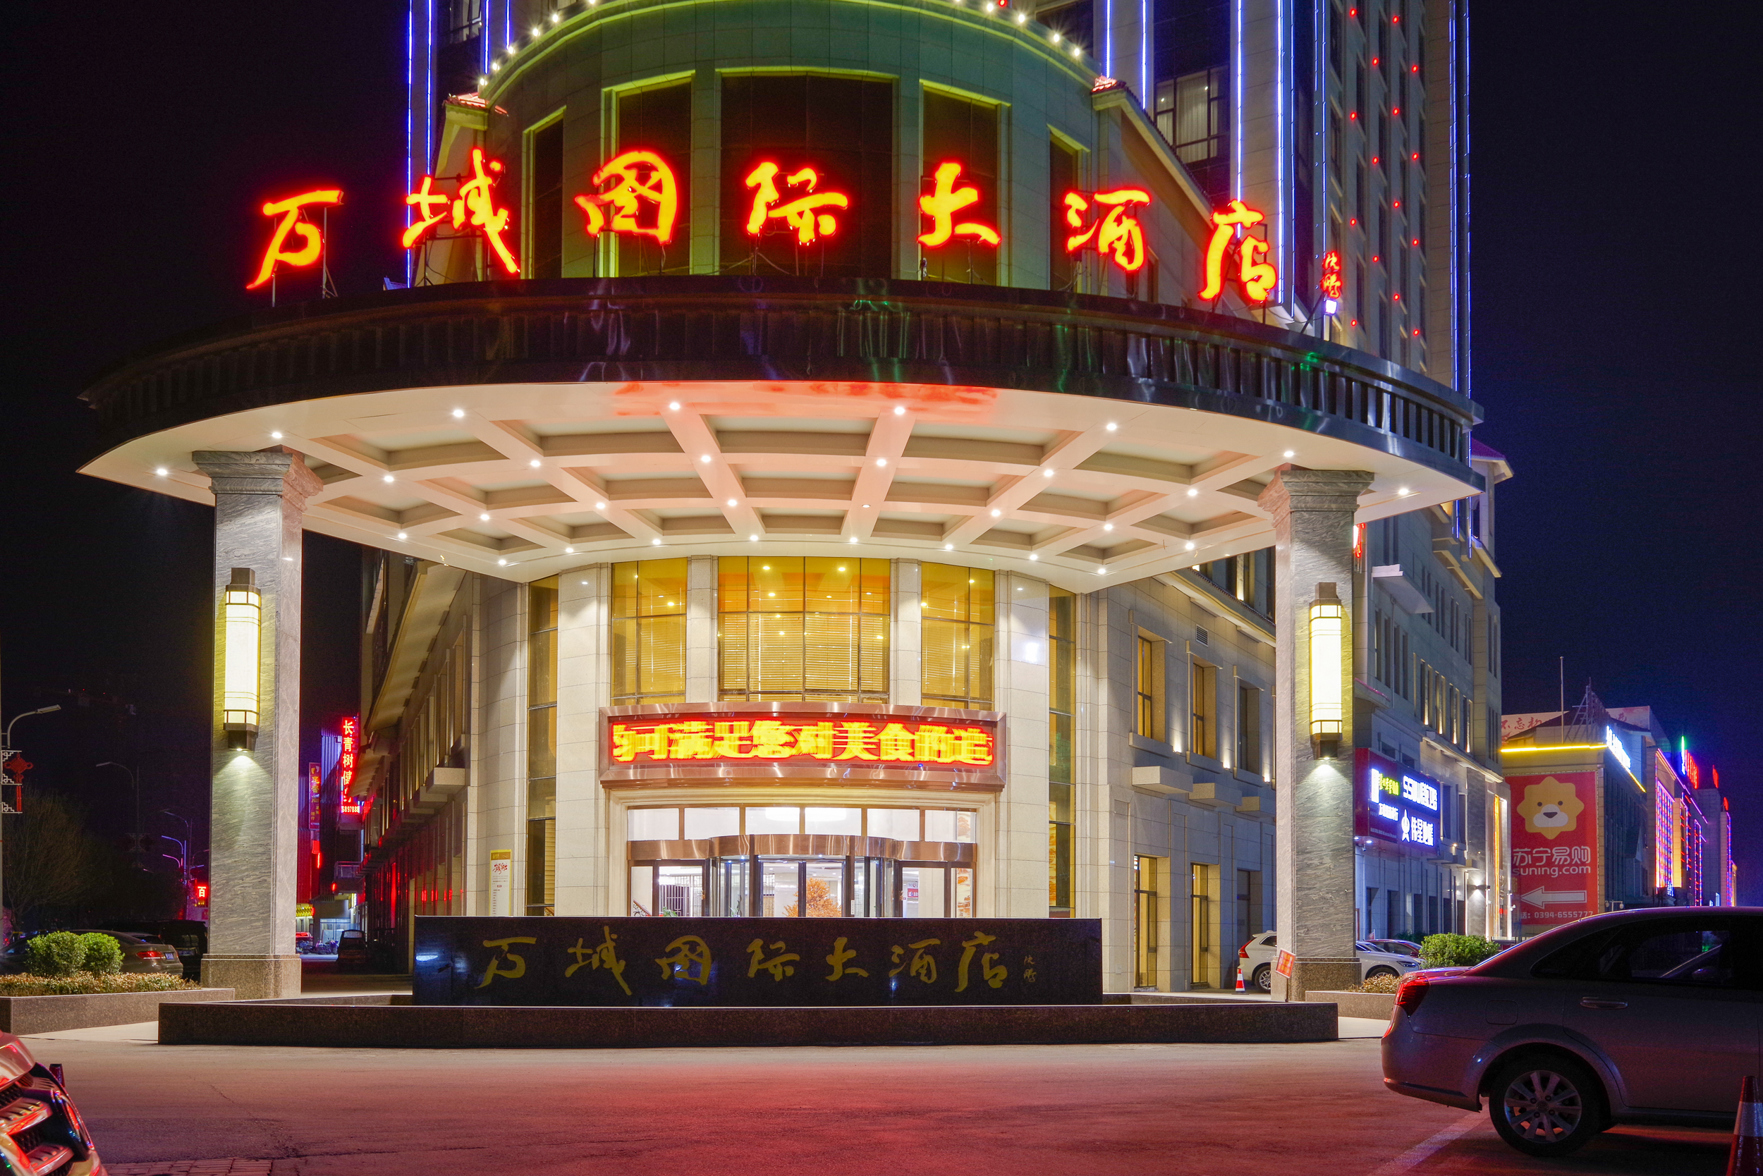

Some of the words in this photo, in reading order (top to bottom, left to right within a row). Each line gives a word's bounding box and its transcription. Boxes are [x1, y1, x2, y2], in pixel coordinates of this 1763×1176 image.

[342, 719, 355, 803] 长青树健
[1512, 845, 1591, 866] 苏宁易购
[1512, 865, 1591, 878] suning.com
[478, 925, 1009, 996] 万城国际大酒店
